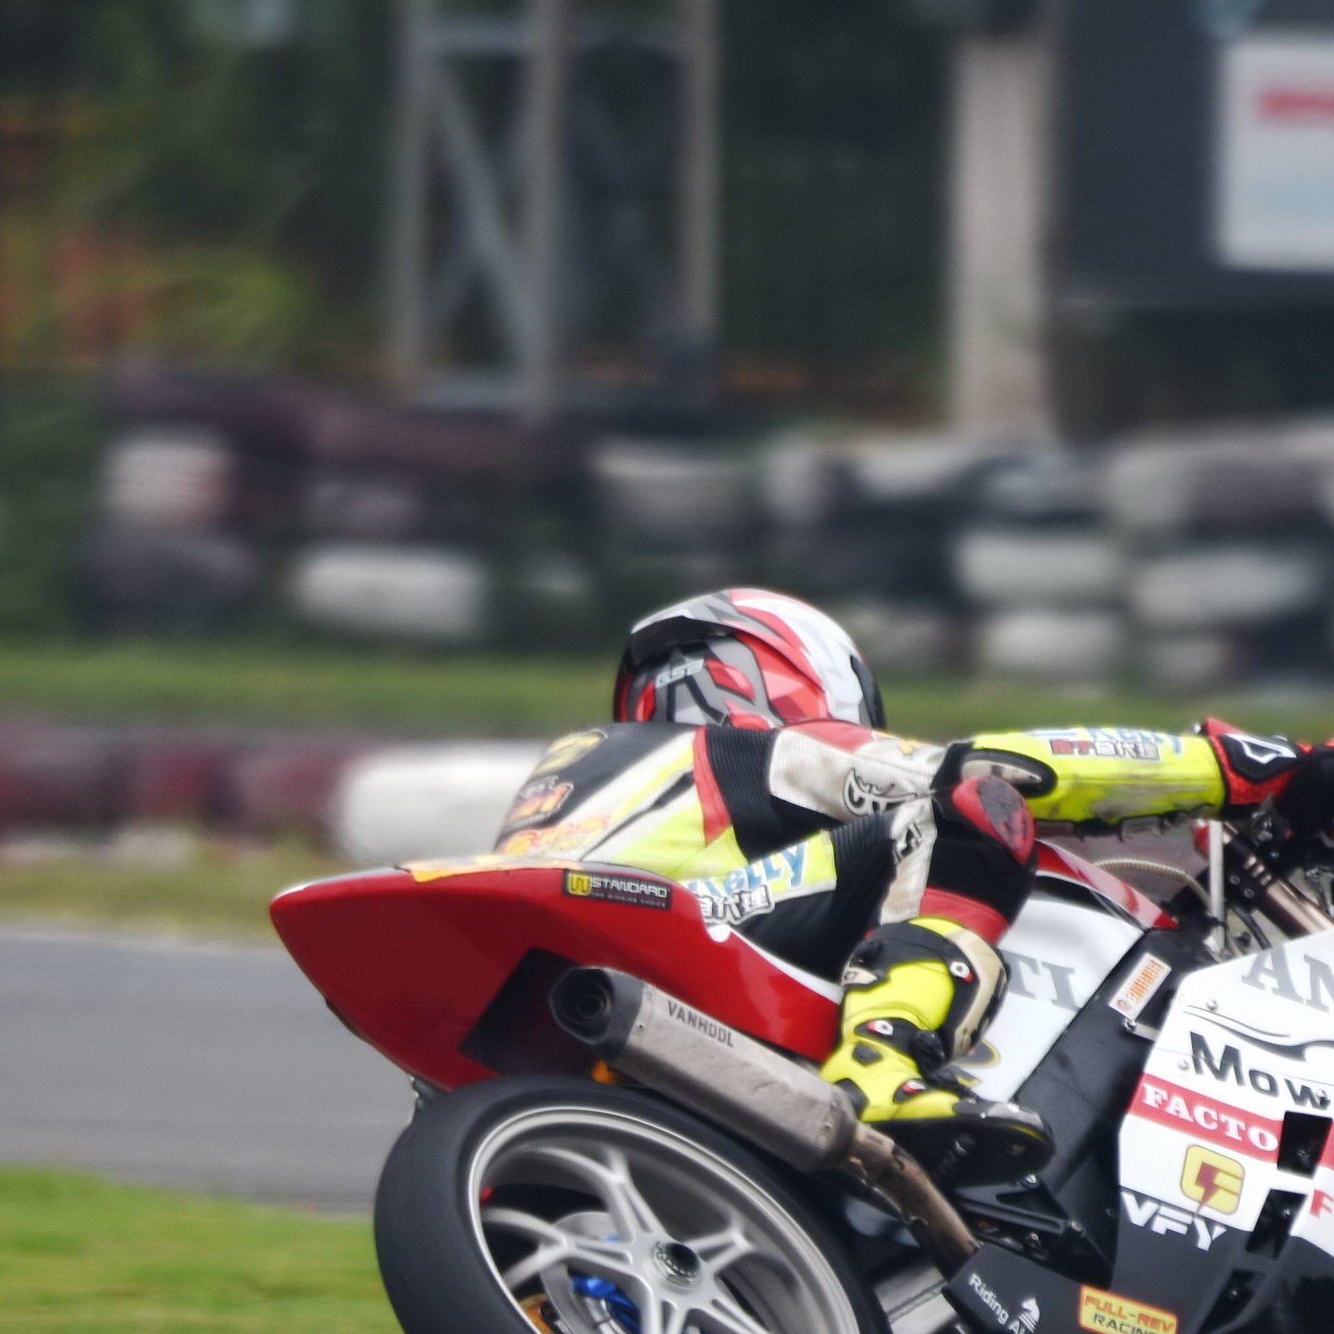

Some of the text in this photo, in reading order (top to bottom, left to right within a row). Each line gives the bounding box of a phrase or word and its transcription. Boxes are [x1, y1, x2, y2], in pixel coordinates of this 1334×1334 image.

[591, 876, 668, 899] STANDARD
[668, 999, 734, 1049] VANHOOL
[1120, 1190, 1227, 1252] VFY
[969, 1272, 1009, 1325] Riding
[1084, 1294, 1175, 1332] FULL-REV
